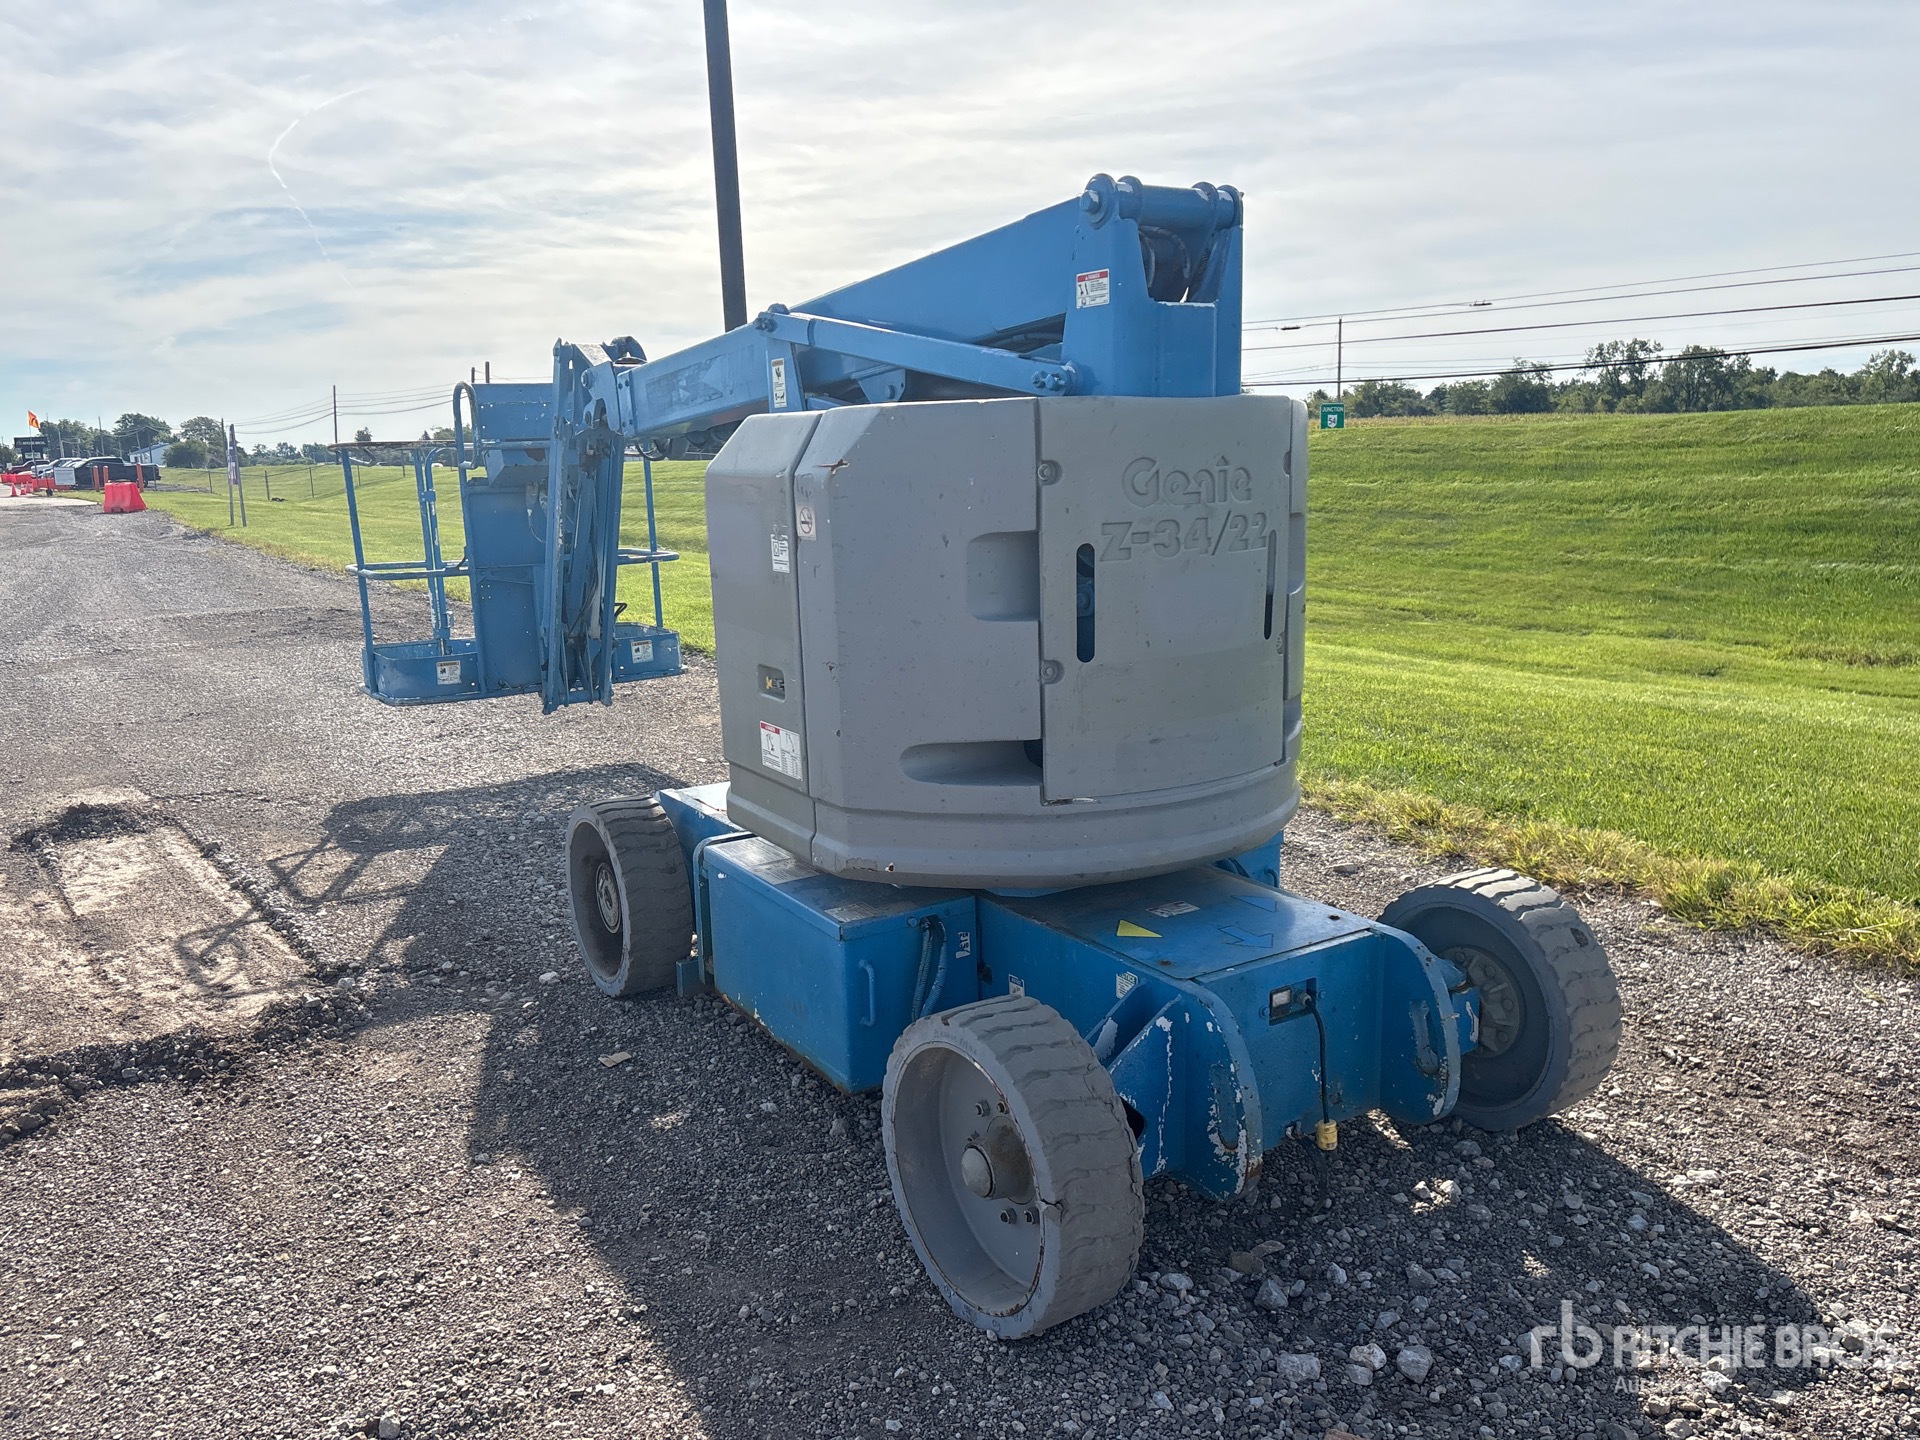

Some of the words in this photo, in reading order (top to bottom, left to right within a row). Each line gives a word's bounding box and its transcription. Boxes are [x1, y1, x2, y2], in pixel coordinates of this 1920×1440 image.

[1328, 417, 1336, 425] 54
[1122, 456, 1252, 507] Genie
[1100, 509, 1268, 562] Z-34/22
